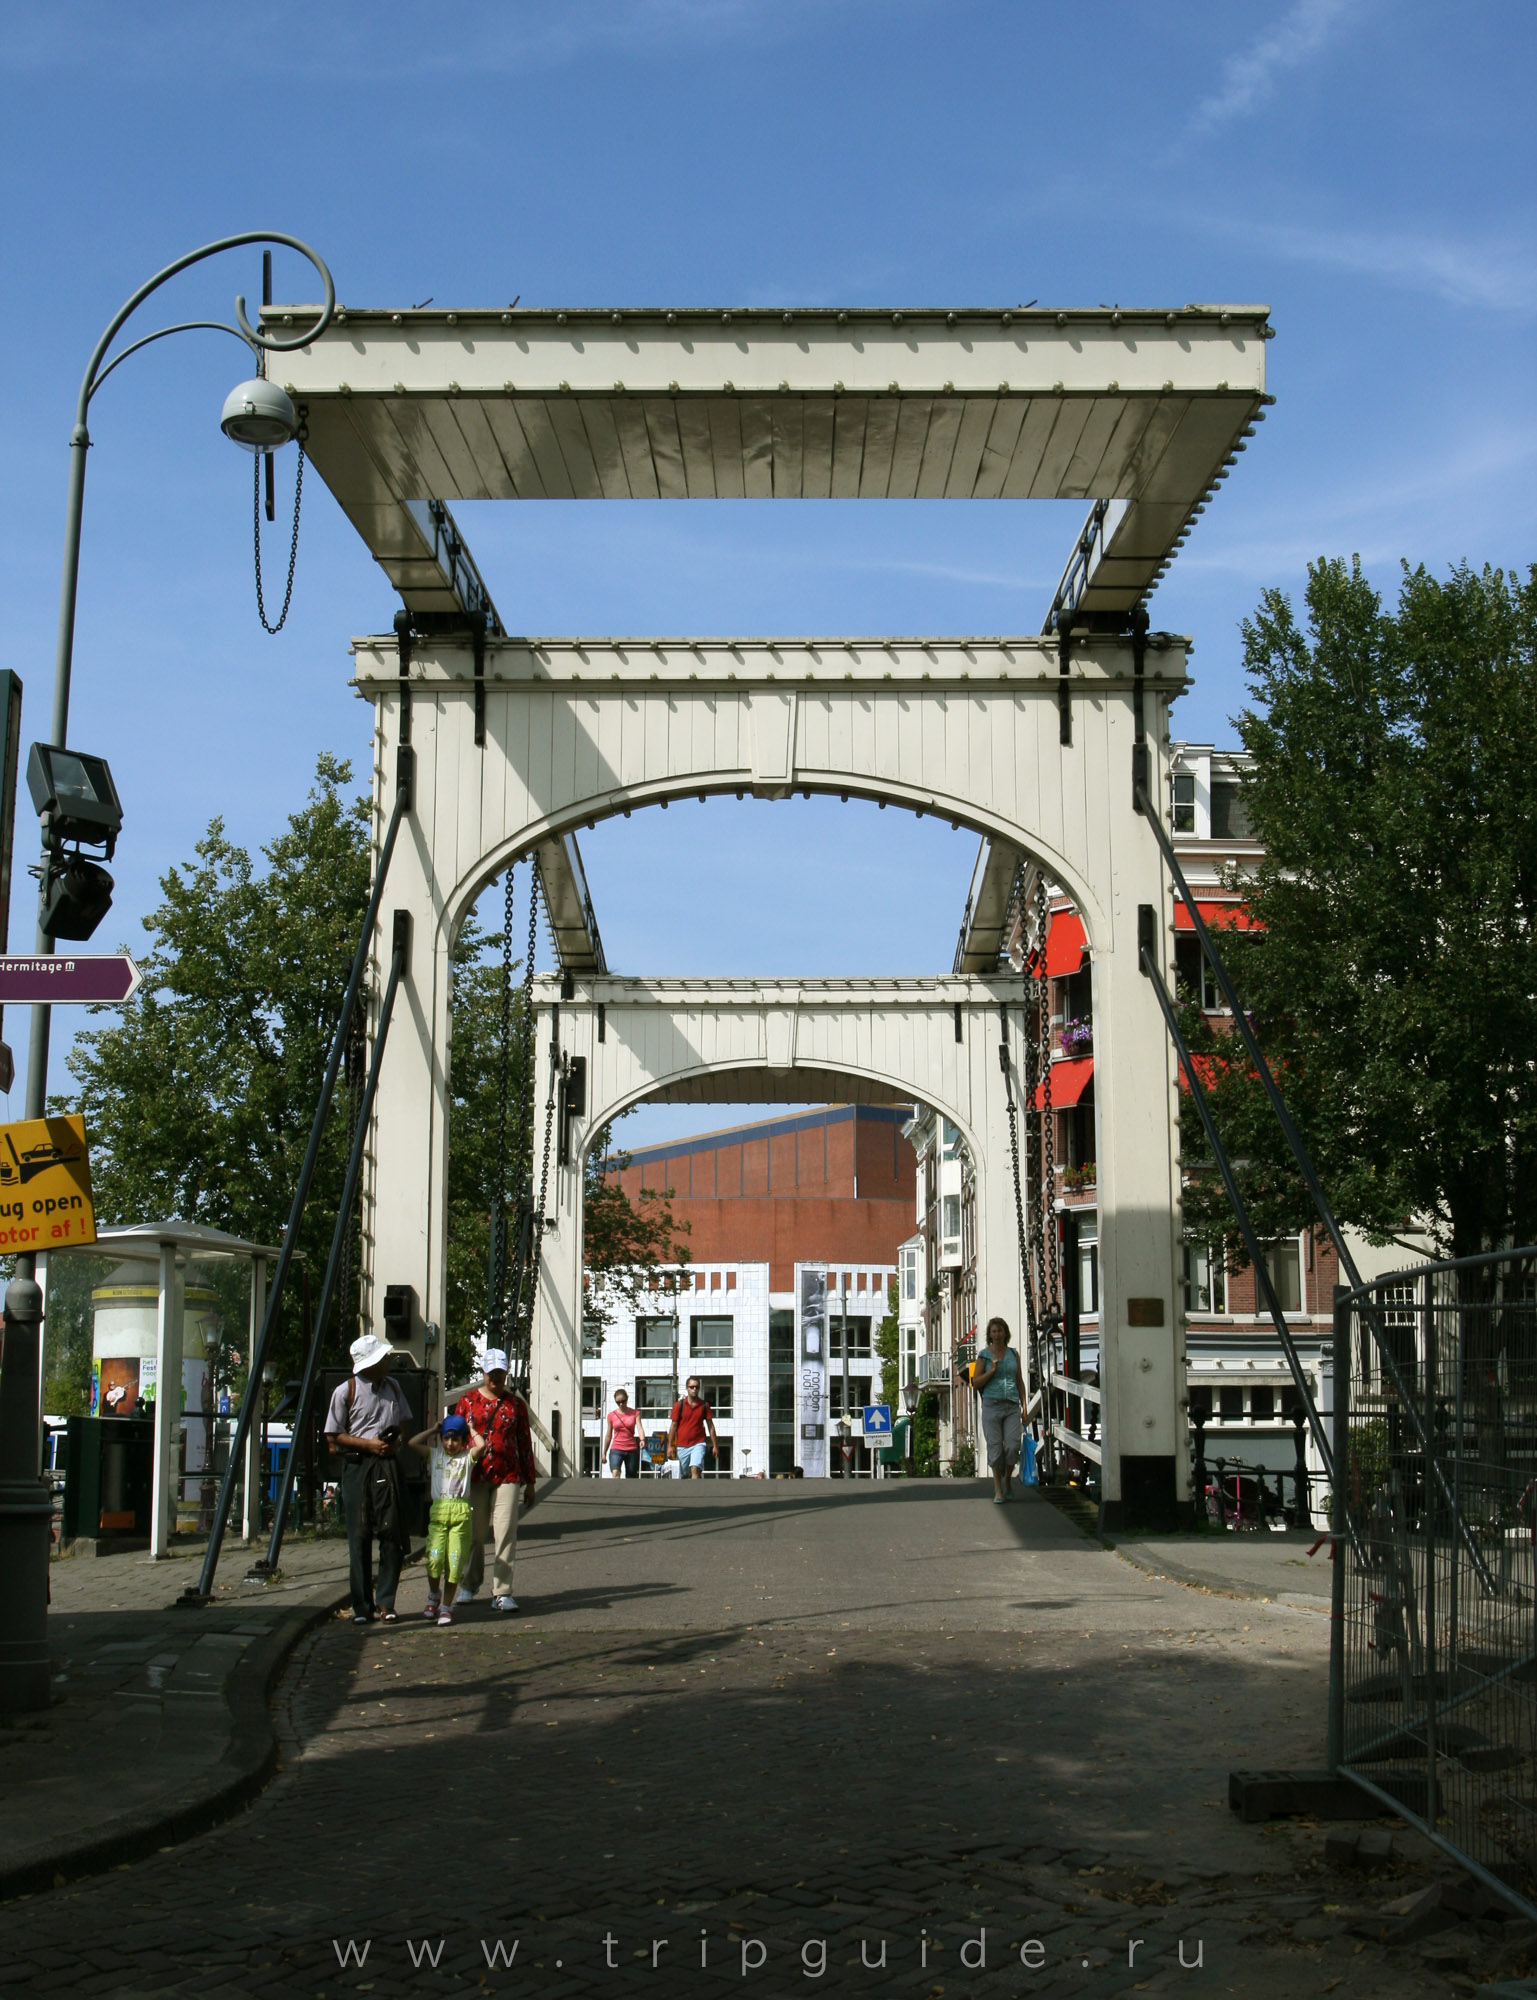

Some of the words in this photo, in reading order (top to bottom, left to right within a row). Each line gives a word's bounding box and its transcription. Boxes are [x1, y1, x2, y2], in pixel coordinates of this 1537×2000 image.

[0, 961, 62, 974] Hermitage
[0, 1202, 24, 1221] ug
[32, 1195, 83, 1215] open
[0, 1225, 40, 1245] otor
[51, 1219, 71, 1239] af
